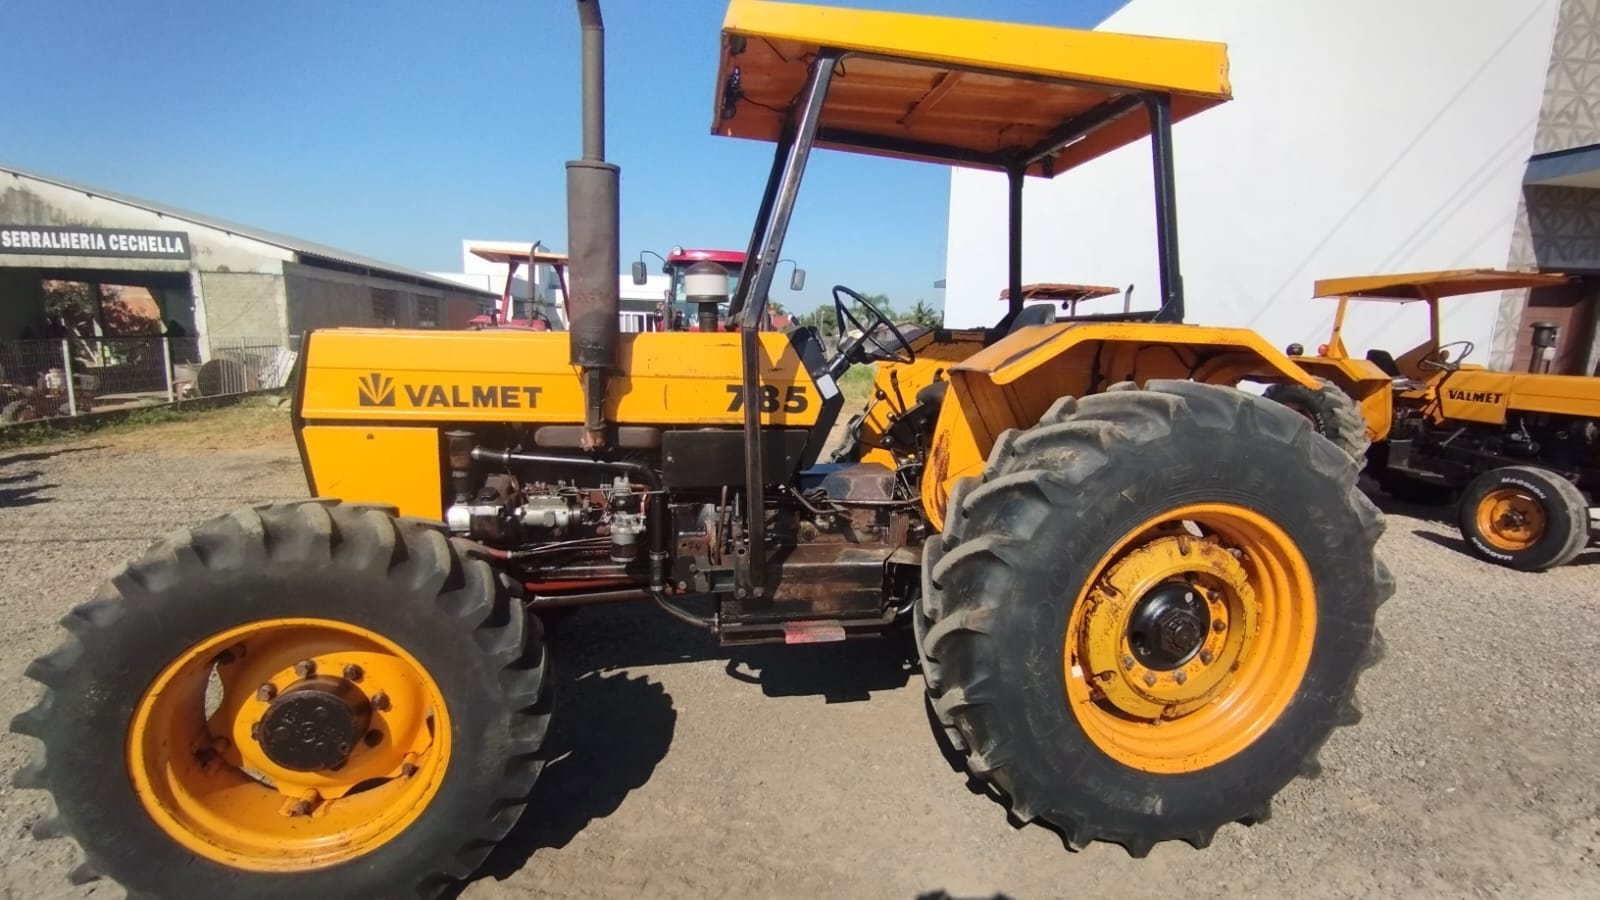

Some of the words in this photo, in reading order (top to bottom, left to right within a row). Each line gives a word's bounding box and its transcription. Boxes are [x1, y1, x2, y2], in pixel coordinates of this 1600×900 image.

[2, 231, 106, 250] SERRALHERIA
[109, 234, 185, 253] CECHELLA
[404, 384, 543, 409] VALMET
[726, 384, 808, 413] 785
[1448, 389, 1503, 404] VALMET
